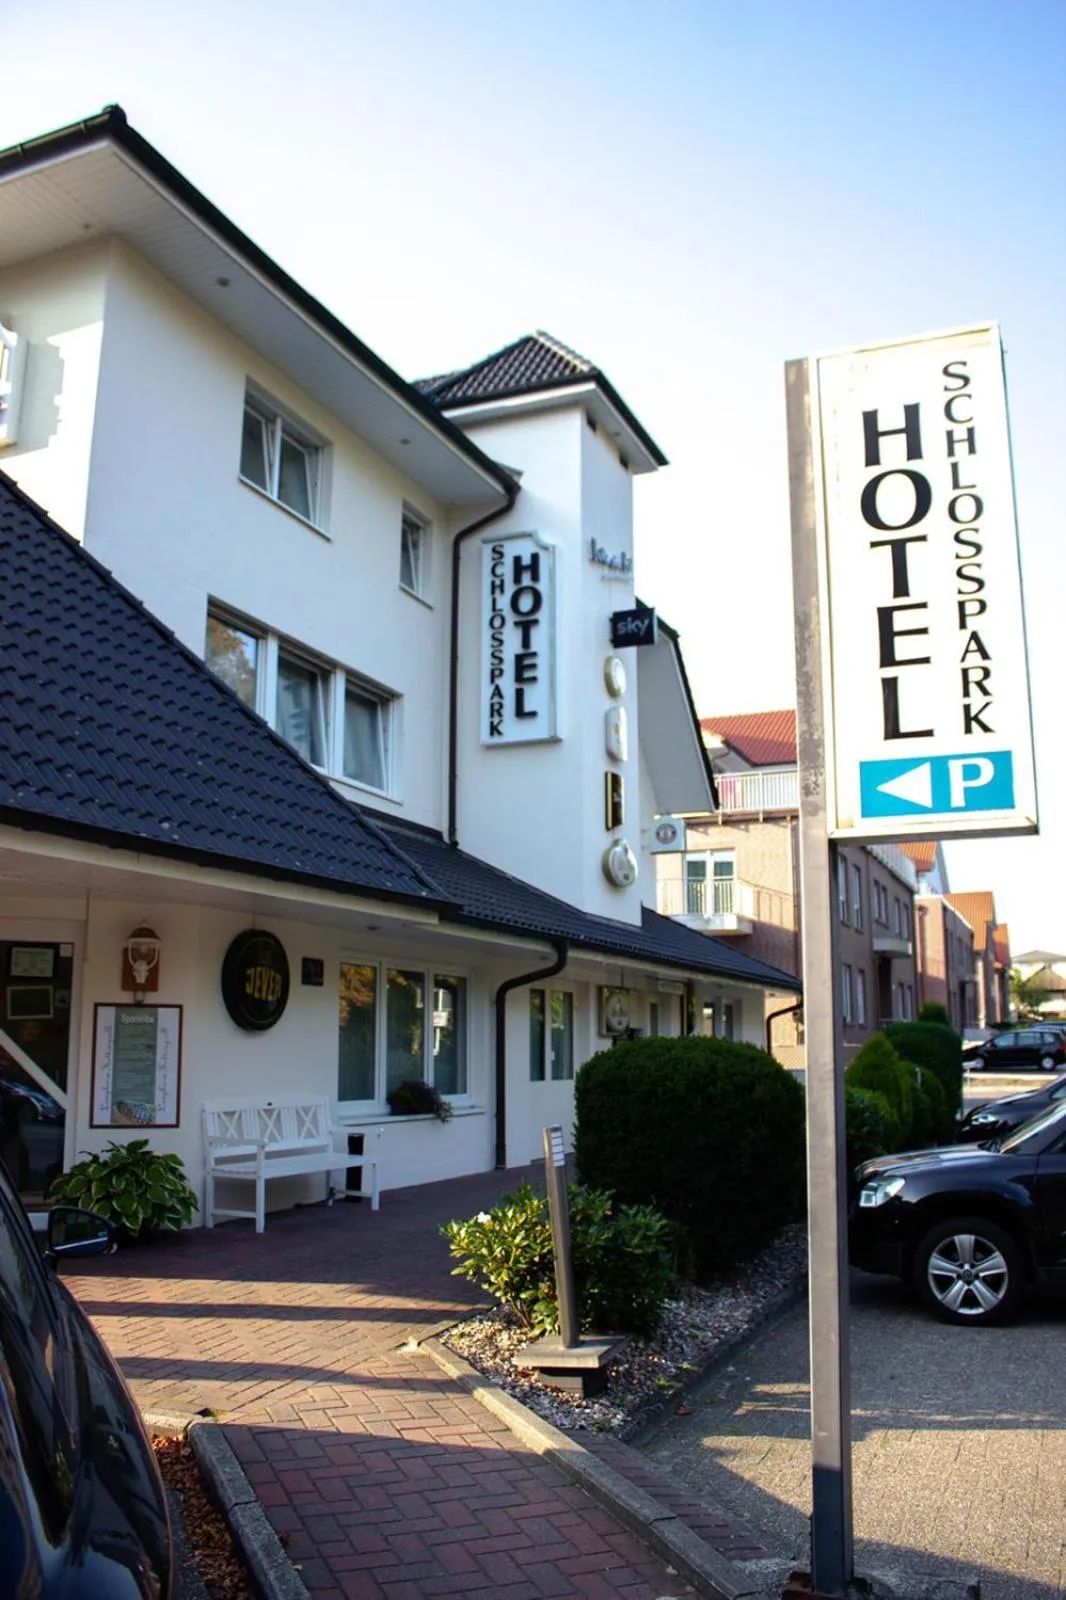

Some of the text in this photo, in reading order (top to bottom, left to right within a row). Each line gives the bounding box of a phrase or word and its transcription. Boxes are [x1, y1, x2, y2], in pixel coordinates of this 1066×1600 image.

[616, 618, 649, 637] sky
[860, 402, 935, 741] HOTEL
[942, 361, 996, 735] SCHLOSSPARK
[489, 545, 505, 737] SCHLOSSPARK
[510, 552, 543, 719] HOTEL
[948, 757, 995, 808] P
[245, 966, 282, 1000] JEVER
